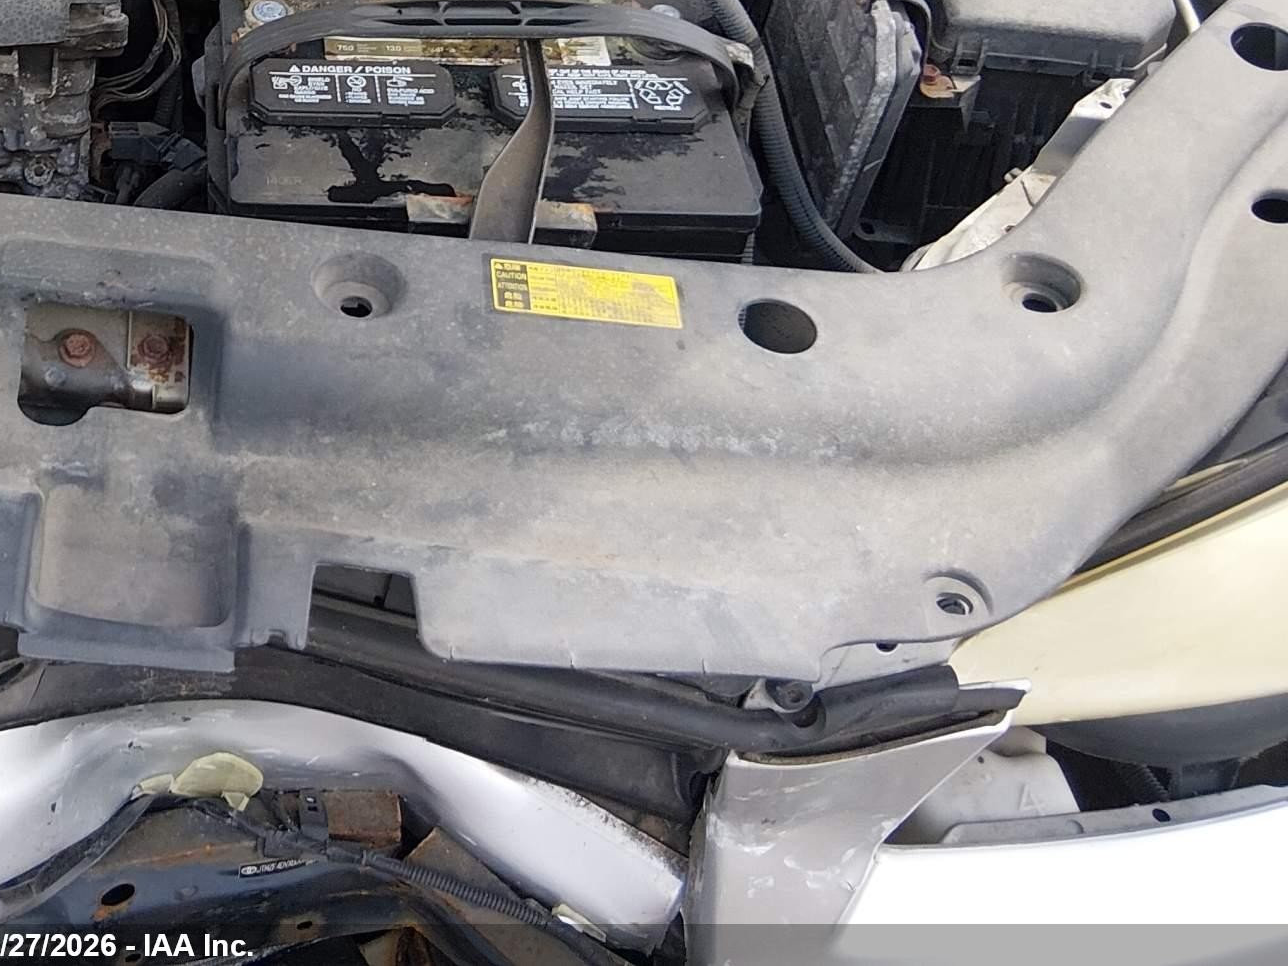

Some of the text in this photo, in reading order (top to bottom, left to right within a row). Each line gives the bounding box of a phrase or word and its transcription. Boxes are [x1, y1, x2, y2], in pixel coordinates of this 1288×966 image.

[302, 65, 411, 75] DANGER / POISON
[496, 271, 527, 281] CAUTION
[497, 281, 528, 291] ATTENTION
